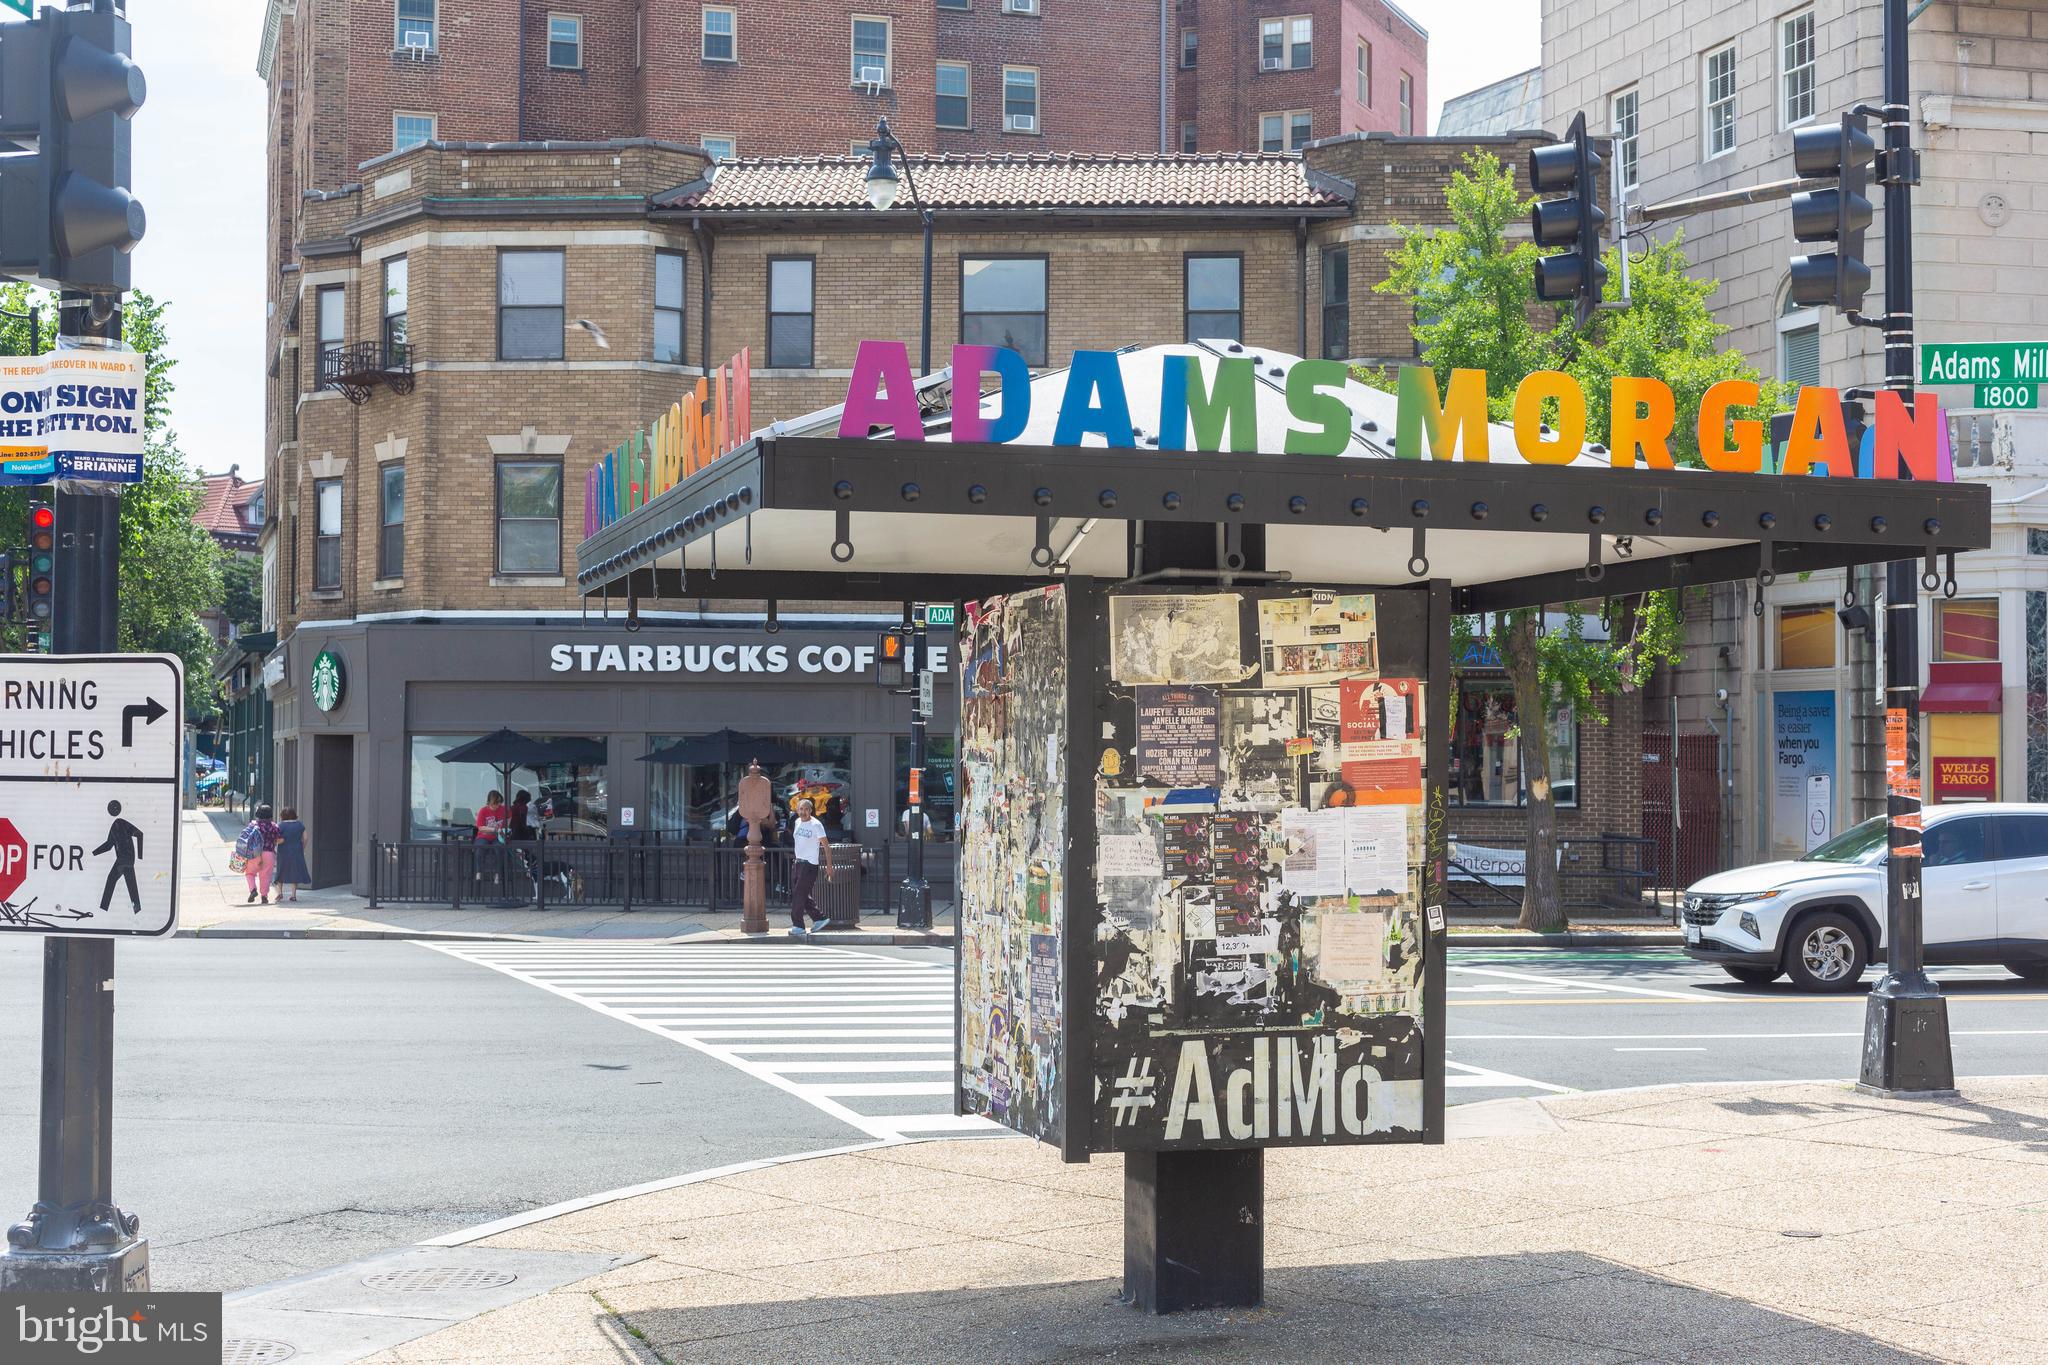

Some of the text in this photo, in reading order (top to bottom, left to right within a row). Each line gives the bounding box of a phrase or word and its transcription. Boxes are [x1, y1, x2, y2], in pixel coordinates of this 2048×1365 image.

[4, 367, 19, 375] THE
[88, 361, 98, 369] IN
[100, 362, 126, 372] WARD
[129, 364, 136, 372] 1.
[1929, 350, 2000, 379] Adams
[56, 384, 137, 410] SIGN
[1983, 386, 2029, 407] 1800
[838, 340, 1352, 457] ADAMS
[1395, 365, 1938, 482] MORGAN
[37, 413, 137, 436] PETITION.
[74, 461, 137, 473] BRIANNE
[1312, 593, 1336, 601] KIDN
[551, 644, 948, 673] STARBUCKS COFE
[1140, 707, 1165, 716] LAUFEY
[1177, 707, 1216, 716] BLEACHERS
[1778, 704, 1831, 721] Being a saver
[1152, 717, 1180, 725] JANELLE
[1778, 720, 1812, 734] is easier
[1778, 736, 1819, 753] when you
[1145, 749, 1168, 758] HOZIER
[1193, 748, 1212, 757] RAPP
[1778, 752, 1805, 768] Fargo.
[1940, 763, 1989, 774] WELLS
[1941, 774, 1989, 785] FARGO
[33, 844, 84, 871] FOR
